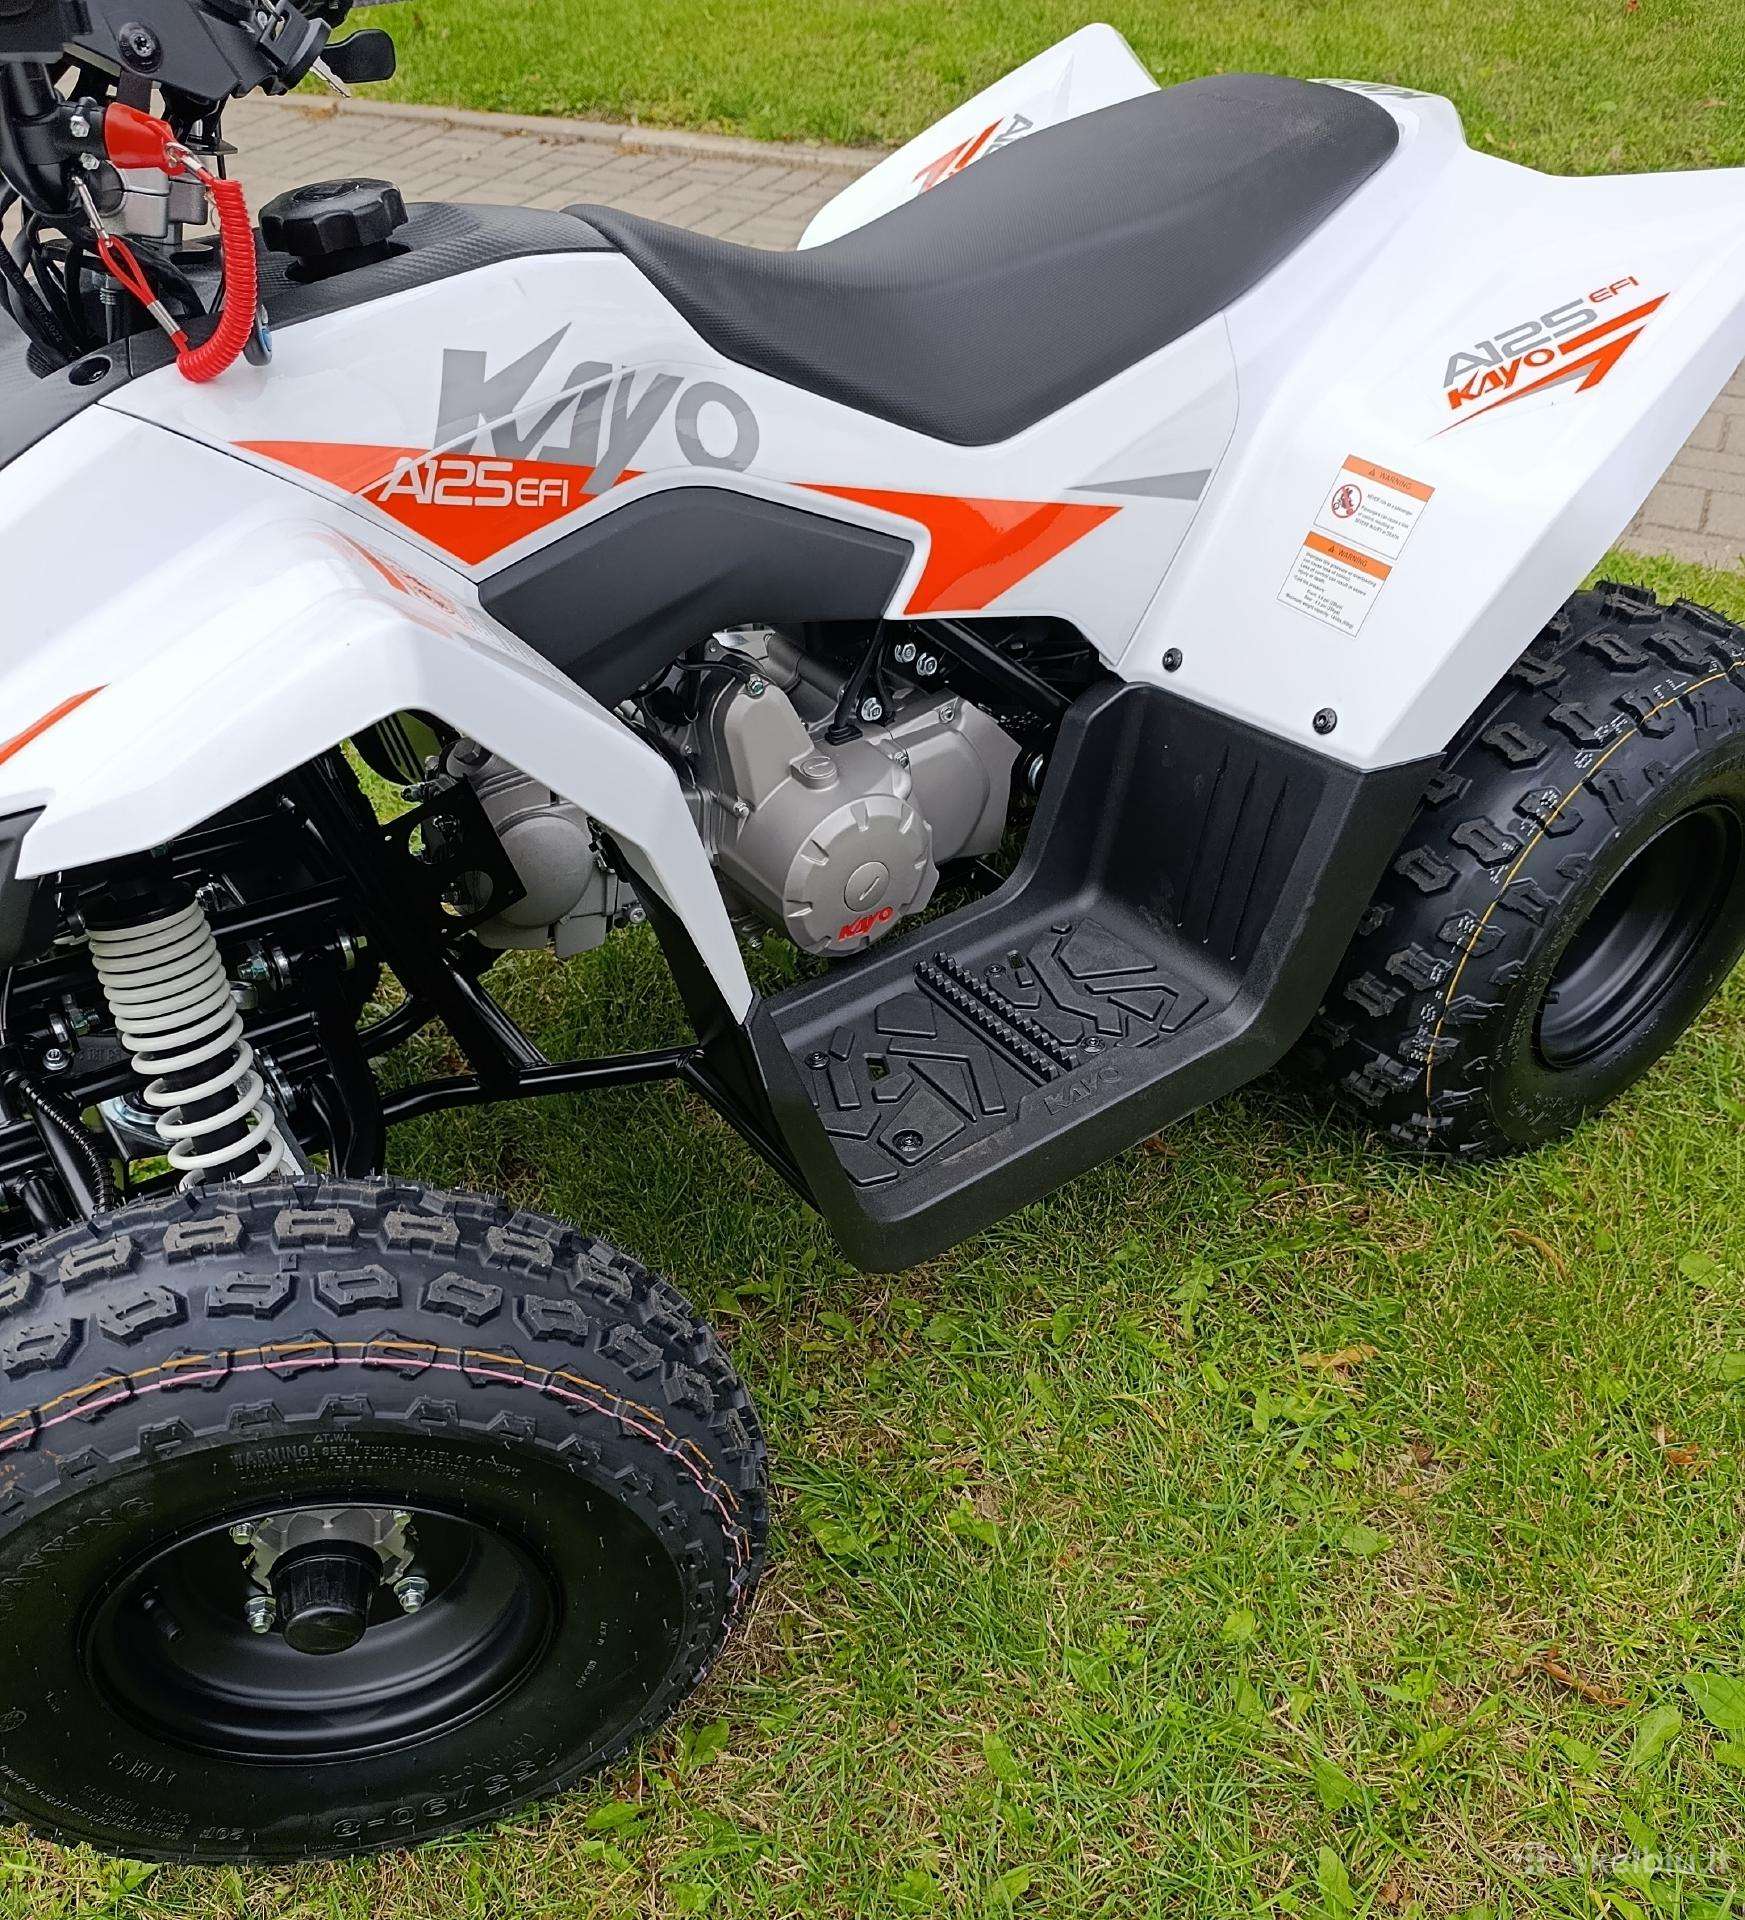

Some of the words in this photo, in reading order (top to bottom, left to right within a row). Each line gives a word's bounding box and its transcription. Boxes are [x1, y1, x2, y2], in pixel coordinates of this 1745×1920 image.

[1443, 298, 1598, 388] A125
[1588, 276, 1639, 303] EFI
[1447, 348, 1555, 410] KAYO
[433, 321, 760, 496] KAYO
[378, 456, 513, 507] A125
[515, 477, 569, 507] EFI
[1379, 471, 1412, 490] WARNING
[1338, 549, 1368, 568] WARNING
[838, 906, 893, 942] KAYO
[1043, 1064, 1121, 1117] KAYO
